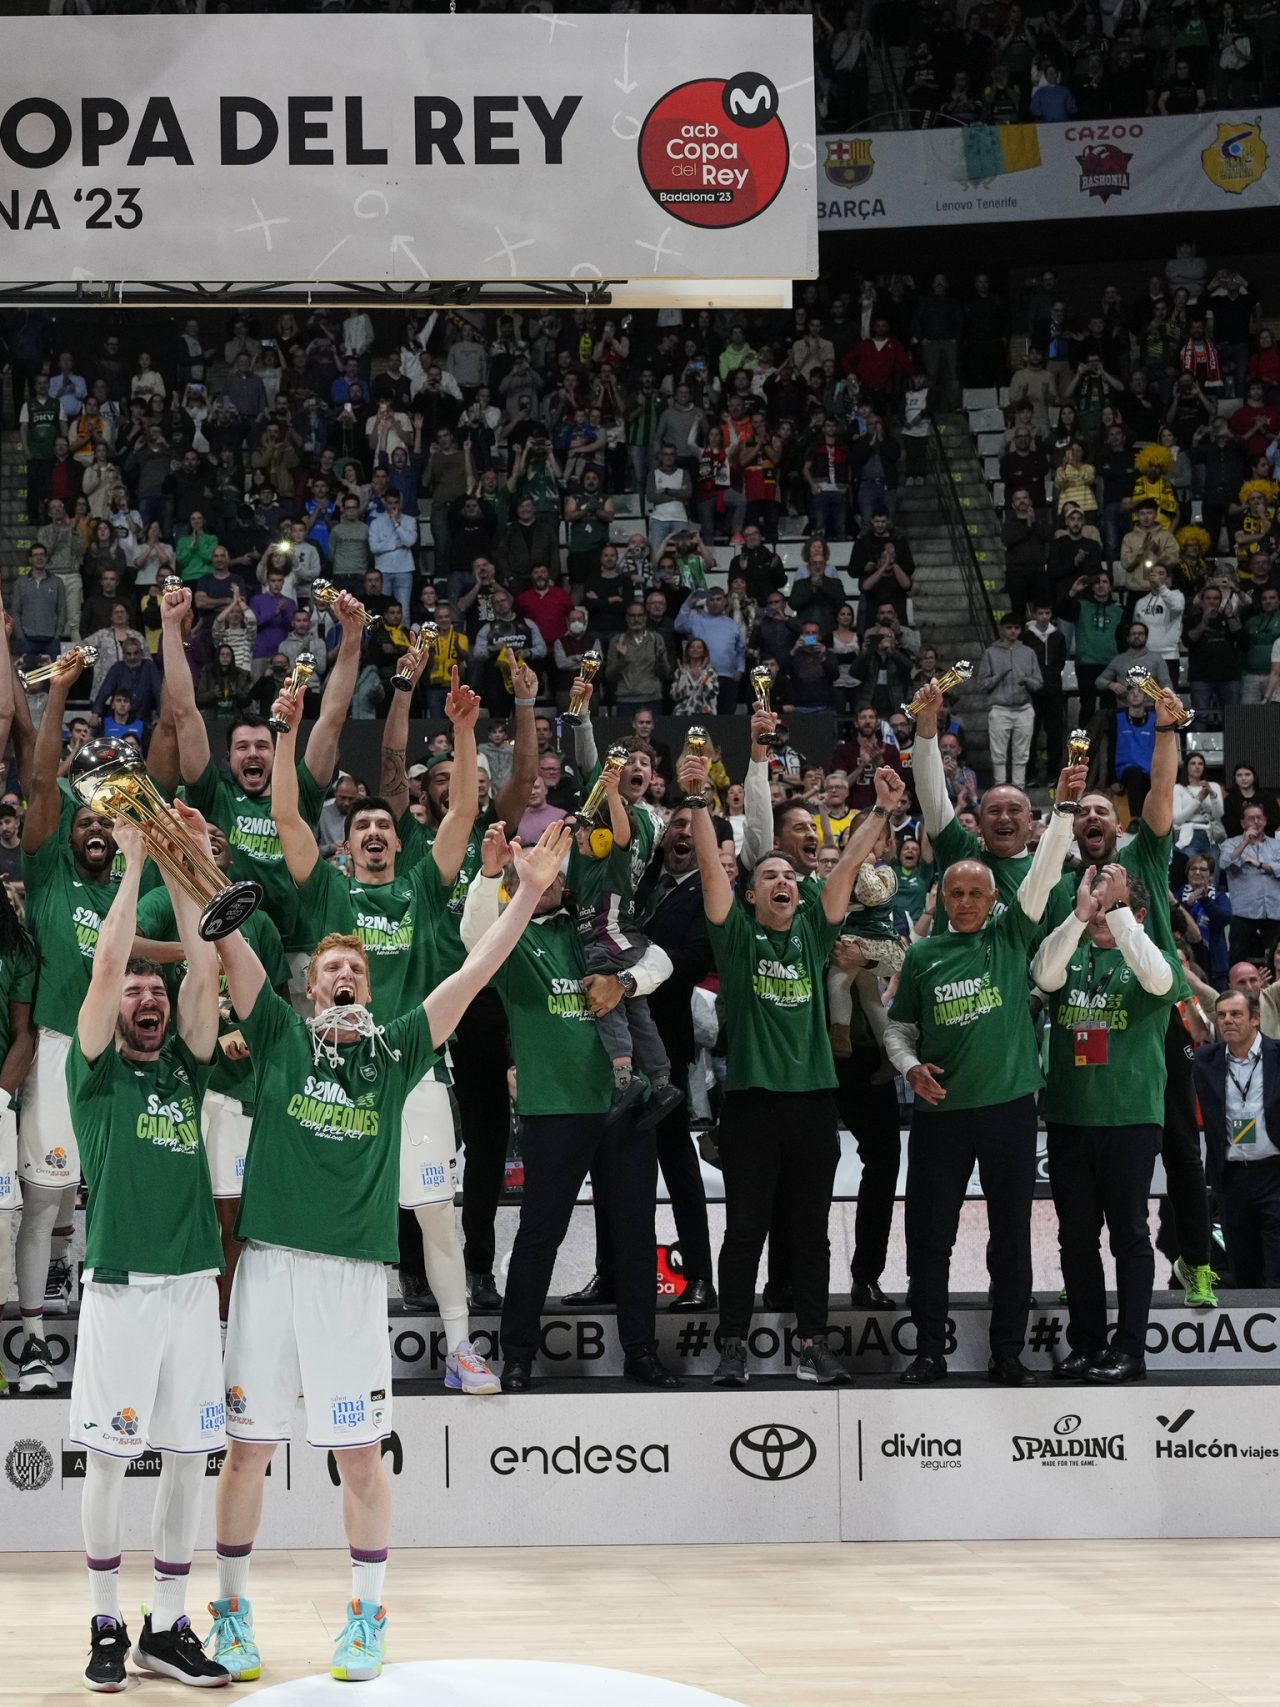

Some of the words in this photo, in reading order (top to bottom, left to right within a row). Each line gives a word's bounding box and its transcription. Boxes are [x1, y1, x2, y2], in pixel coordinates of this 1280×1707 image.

[220, 96, 388, 166] DEL
[414, 96, 584, 165] REY
[680, 122, 719, 138] acb
[1065, 124, 1144, 142] CAZOO
[666, 138, 739, 166] Copa
[671, 161, 697, 177] del
[702, 165, 749, 191] Rey
[659, 190, 715, 202] Badalona
[935, 199, 972, 212] Lenovo
[976, 196, 1018, 209] Tenerife
[493, 634, 527, 645] Lenovo
[933, 977, 982, 1003] S2MOS
[304, 1075, 355, 1108] S2MOS
[287, 1093, 380, 1137] CAMPEONES
[300, 1119, 322, 1130] COPA
[323, 1124, 345, 1135] DEL
[345, 1129, 365, 1140] REY
[421, 1174, 446, 1187] laga
[337, 1395, 365, 1412] má
[333, 1410, 365, 1427] laga
[490, 1436, 670, 1475] endesa
[881, 1433, 962, 1457] divina
[1012, 1434, 1128, 1463] SPALDING
[1155, 1439, 1238, 1459] Halcón
[1240, 1447, 1280, 1460] viajes
[920, 1460, 962, 1471] seguros
